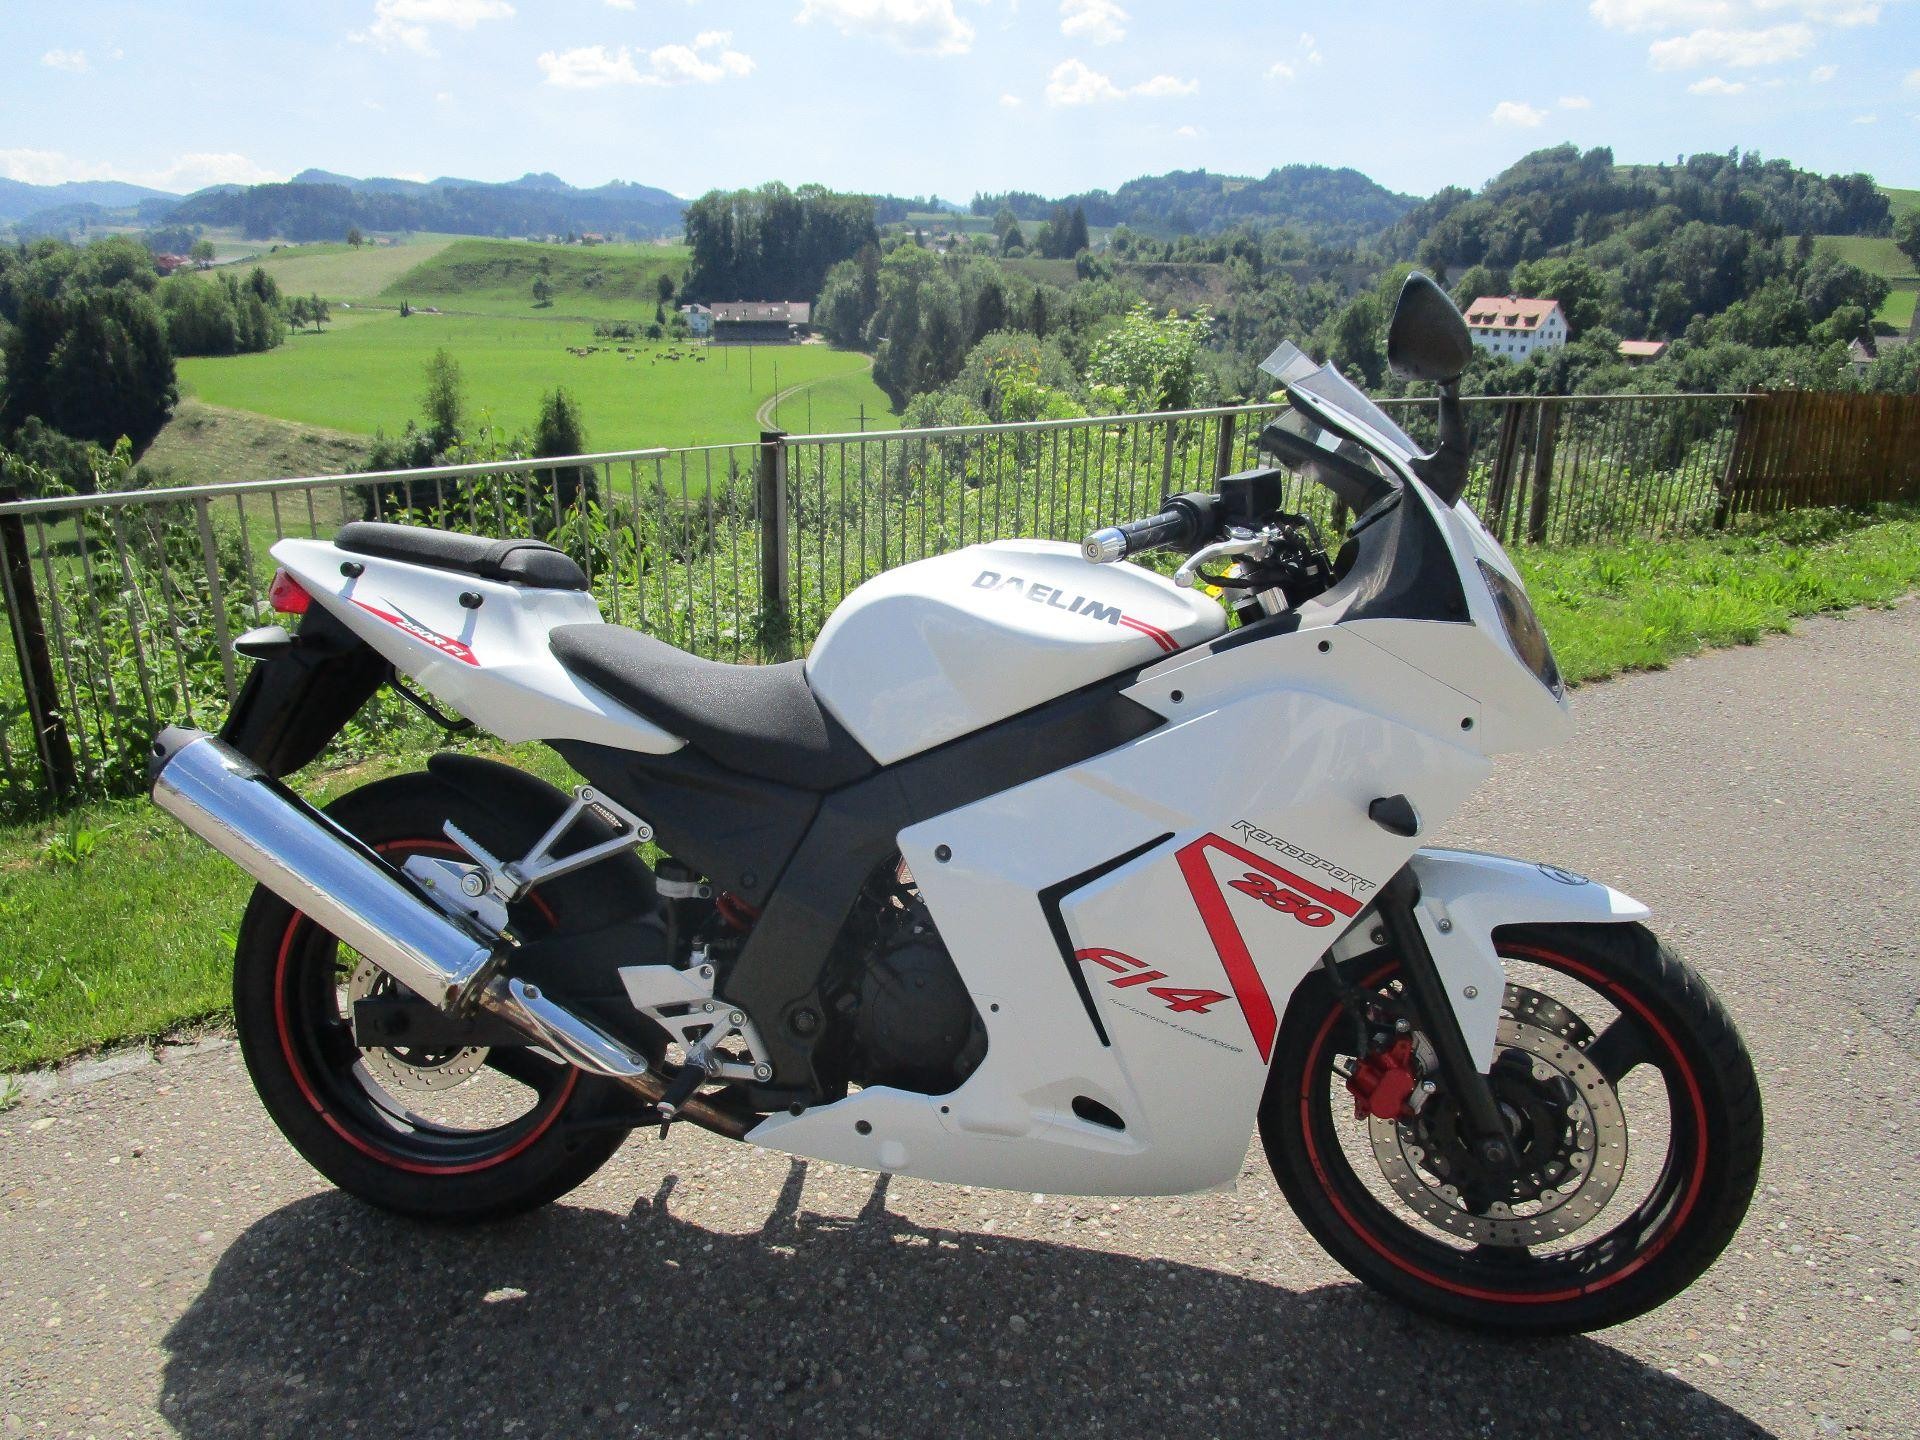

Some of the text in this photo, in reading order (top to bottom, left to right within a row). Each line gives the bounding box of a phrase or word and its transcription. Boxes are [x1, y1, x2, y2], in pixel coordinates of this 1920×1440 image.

[971, 570, 1122, 626] DAELIM
[1231, 820, 1377, 895] ROADSPORT
[1227, 872, 1336, 927] 250
